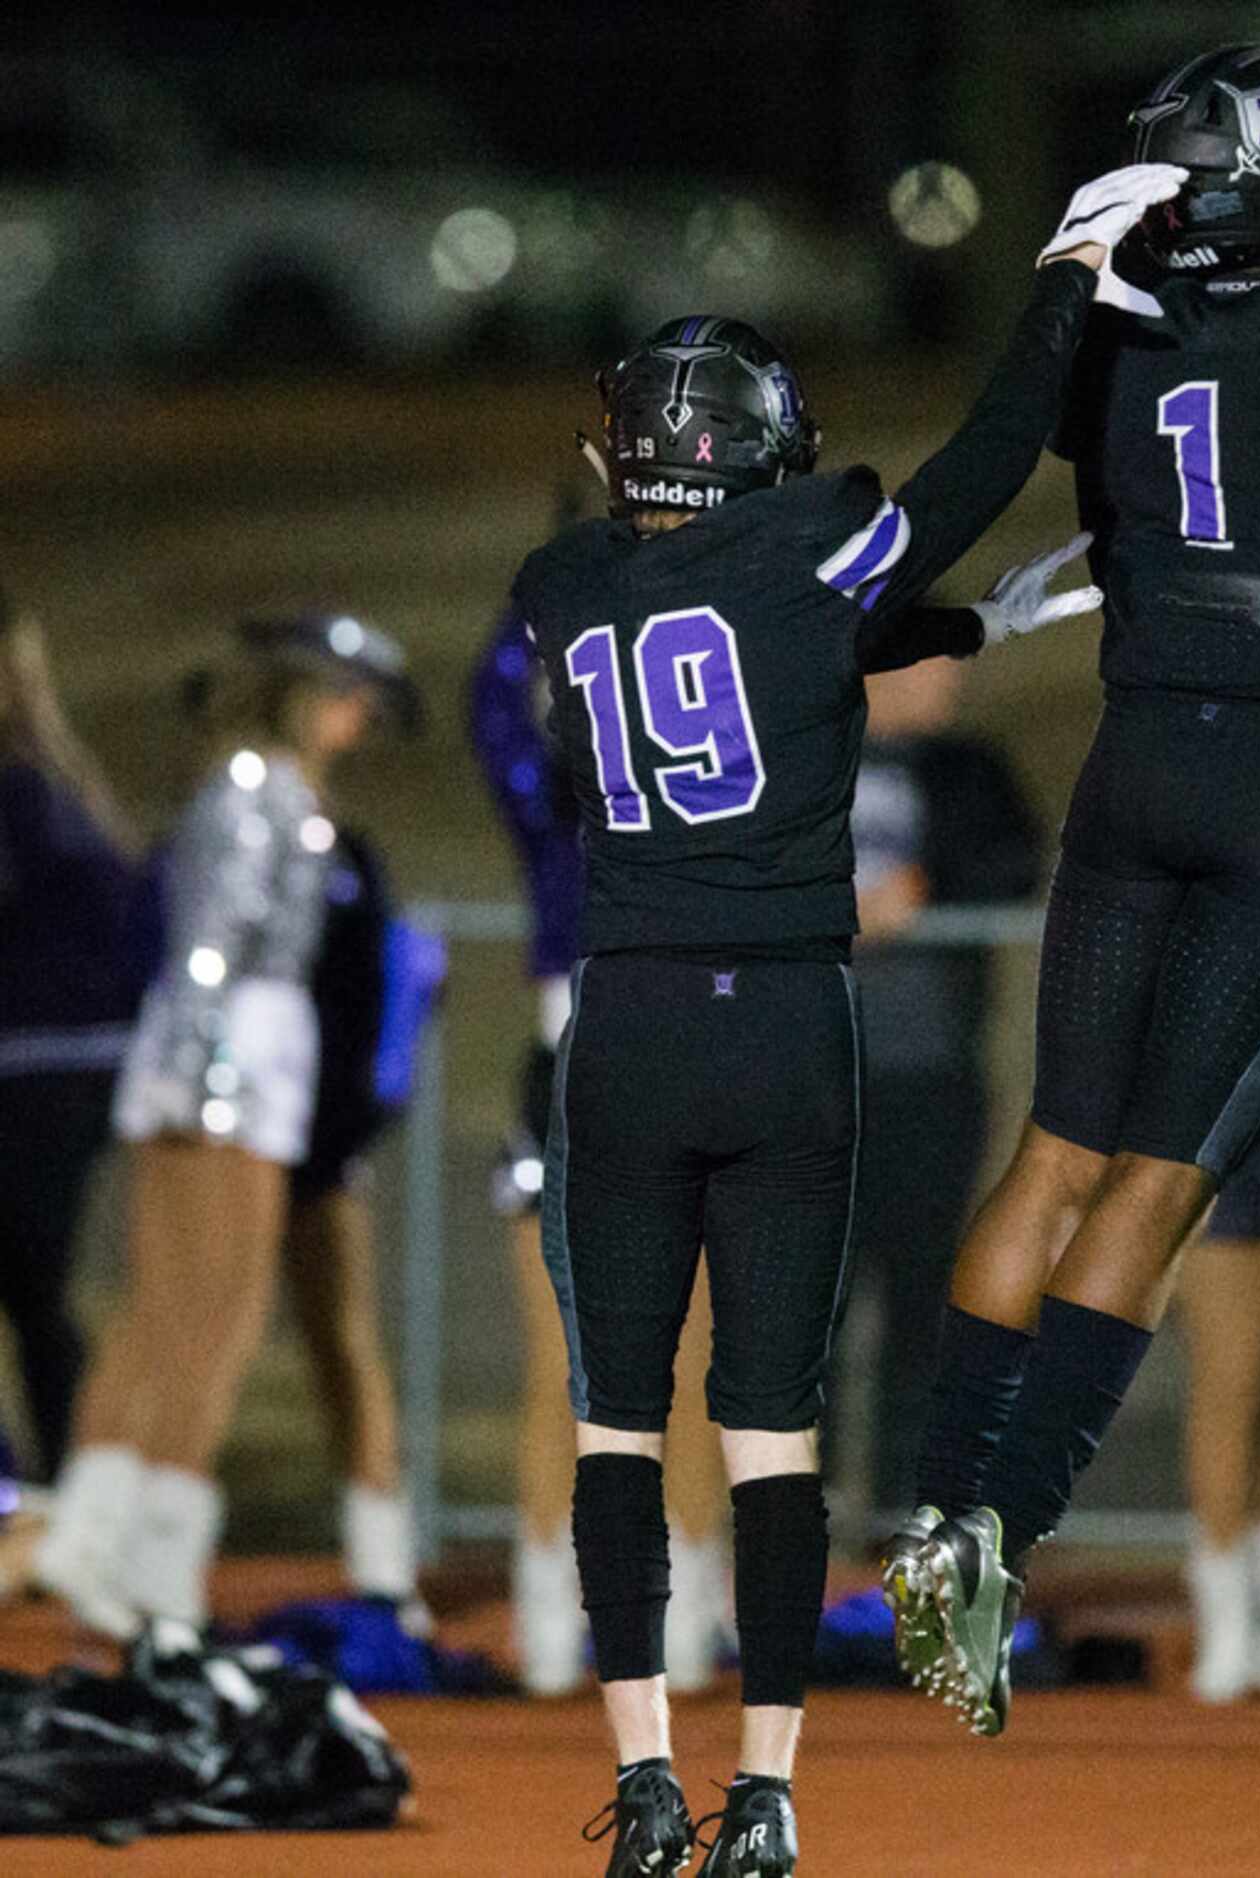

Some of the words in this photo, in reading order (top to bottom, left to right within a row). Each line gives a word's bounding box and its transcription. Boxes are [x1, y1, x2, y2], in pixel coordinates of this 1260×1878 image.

[623, 479, 726, 508] Riddell
[636, 437, 655, 459] 19
[1157, 380, 1234, 550] 1
[565, 605, 767, 831] 19
